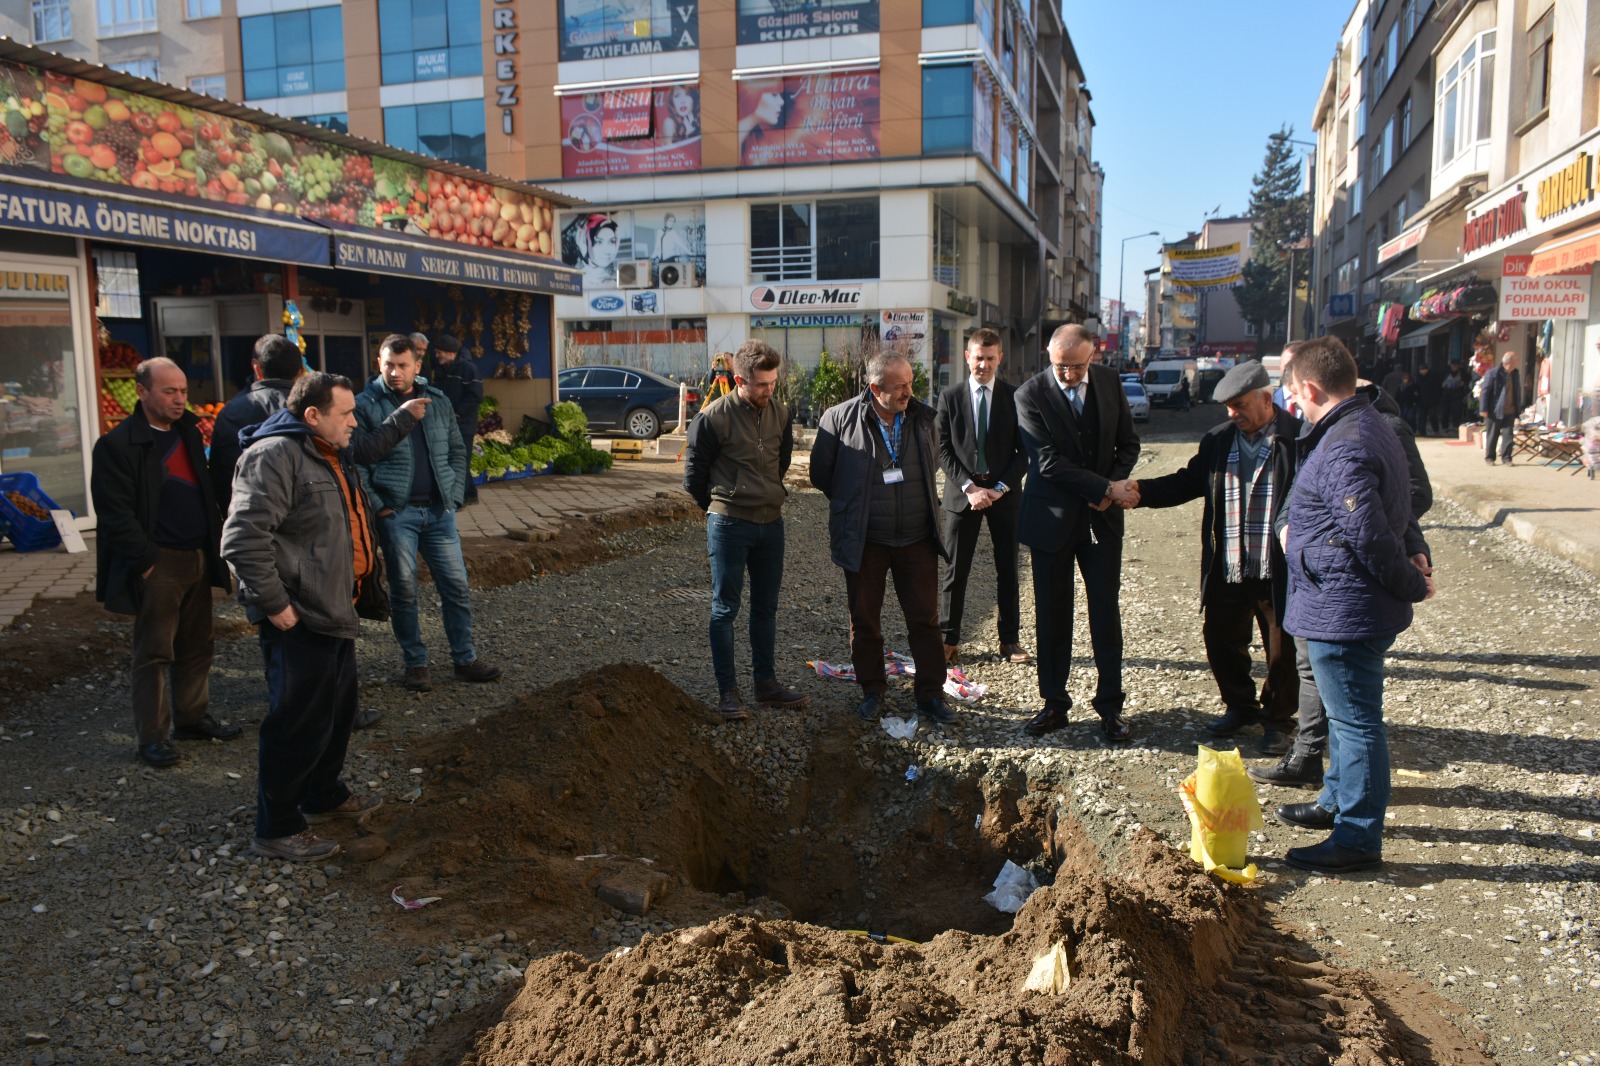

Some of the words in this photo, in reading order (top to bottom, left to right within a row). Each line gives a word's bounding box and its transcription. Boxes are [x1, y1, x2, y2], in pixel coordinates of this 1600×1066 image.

[757, 12, 809, 28] Güzellik
[812, 9, 859, 24] Salonu
[760, 24, 859, 42] KUAFÖR
[582, 40, 663, 59] ZAYIFLAMA
[493, 0, 520, 136] RKEZİ
[790, 73, 871, 99] Almira
[810, 95, 856, 111] Bayan
[614, 110, 649, 126] Bayan
[803, 111, 864, 136] Kuaförü
[1536, 152, 1592, 220] SARIGÜL
[95, 200, 170, 239] ÖDEME
[174, 219, 257, 251] NOKTASI
[339, 243, 364, 265] ŞEN
[367, 247, 407, 269] MANAV
[421, 257, 460, 276] SEBZE
[464, 263, 500, 281] MEYVE
[1510, 278, 1540, 290] TÜM
[1543, 279, 1581, 290] OKUL
[596, 297, 618, 310] Ford
[778, 288, 861, 305] Oleo-Mac
[1505, 293, 1585, 304] FORMALARI
[892, 312, 925, 322] Oleo-Mac
[1511, 306, 1577, 317] BULUNUR
[779, 315, 851, 327] HYUNDAI
